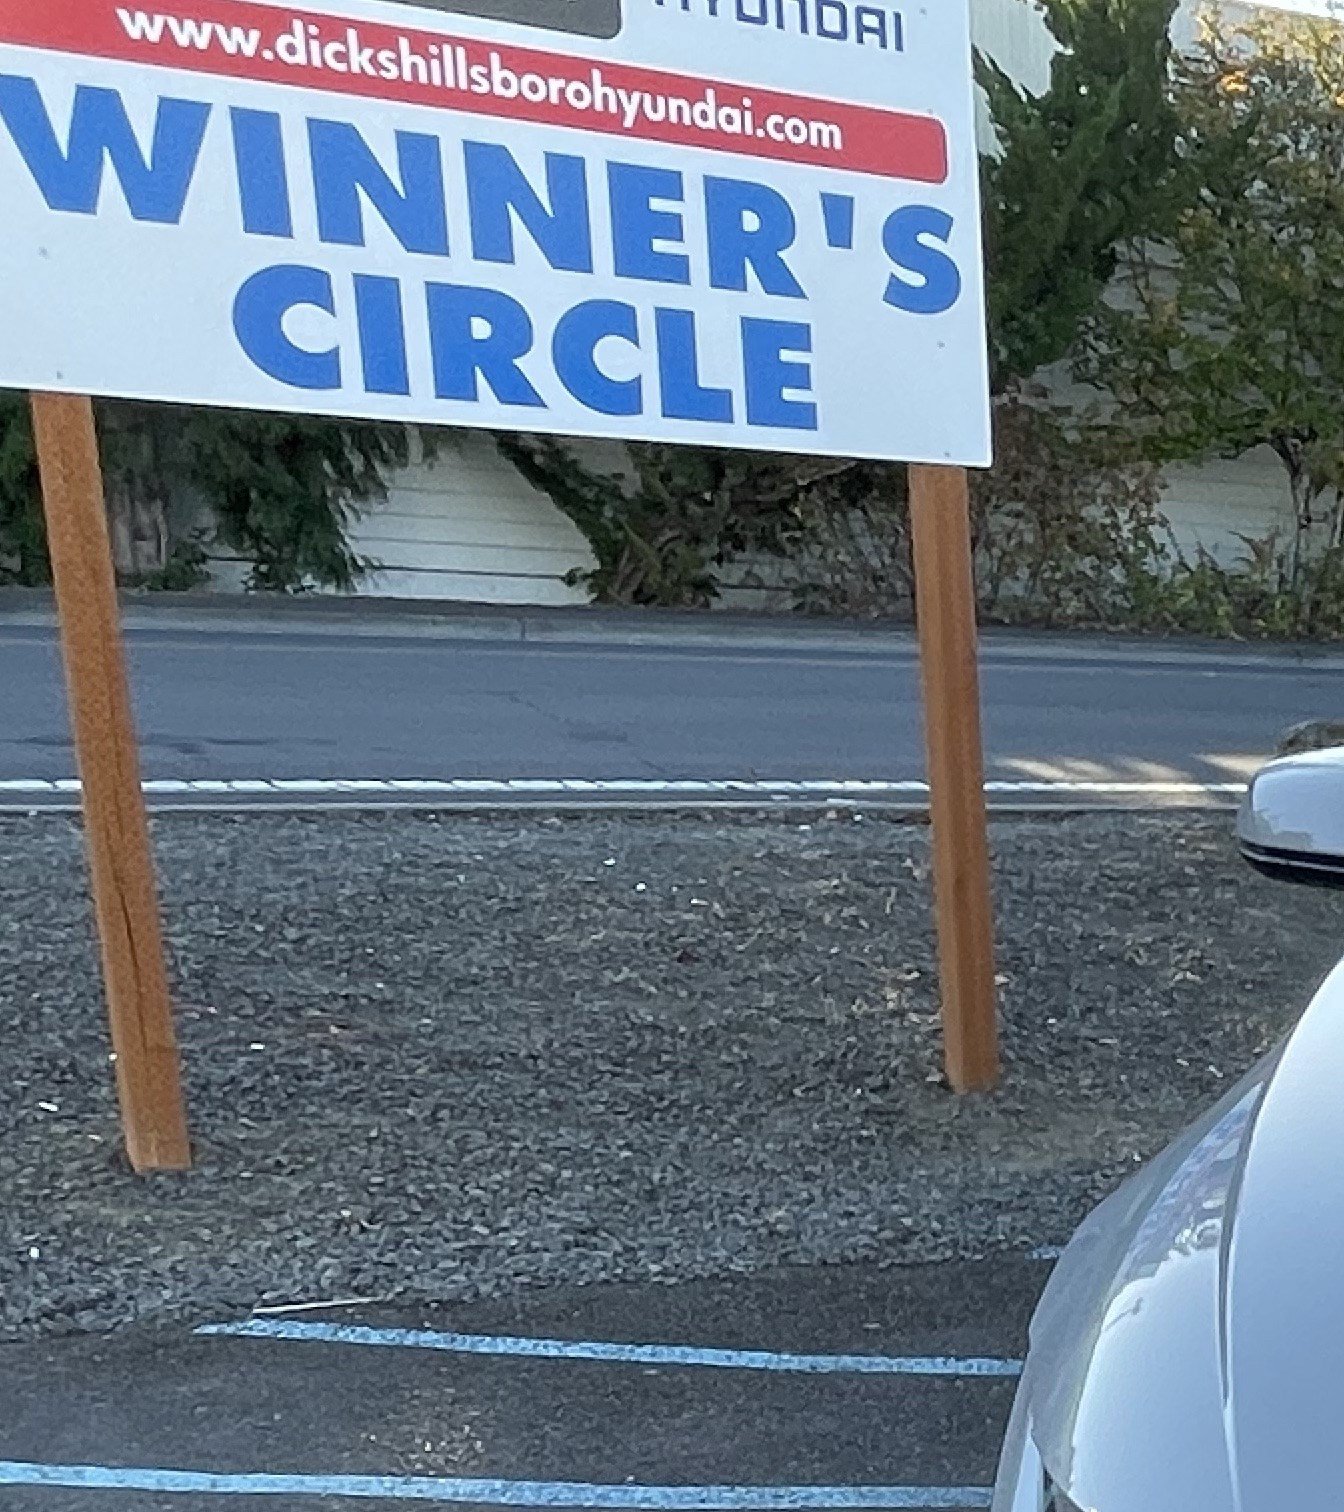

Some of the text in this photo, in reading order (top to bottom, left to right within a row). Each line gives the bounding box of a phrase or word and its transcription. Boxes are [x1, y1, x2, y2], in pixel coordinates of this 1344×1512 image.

[116, 8, 844, 151] www.dickshillsborohyundai.com
[656, 0, 903, 51] UNDAI
[0, 74, 961, 315] WINNER'S
[232, 263, 819, 431] CIRCLE
